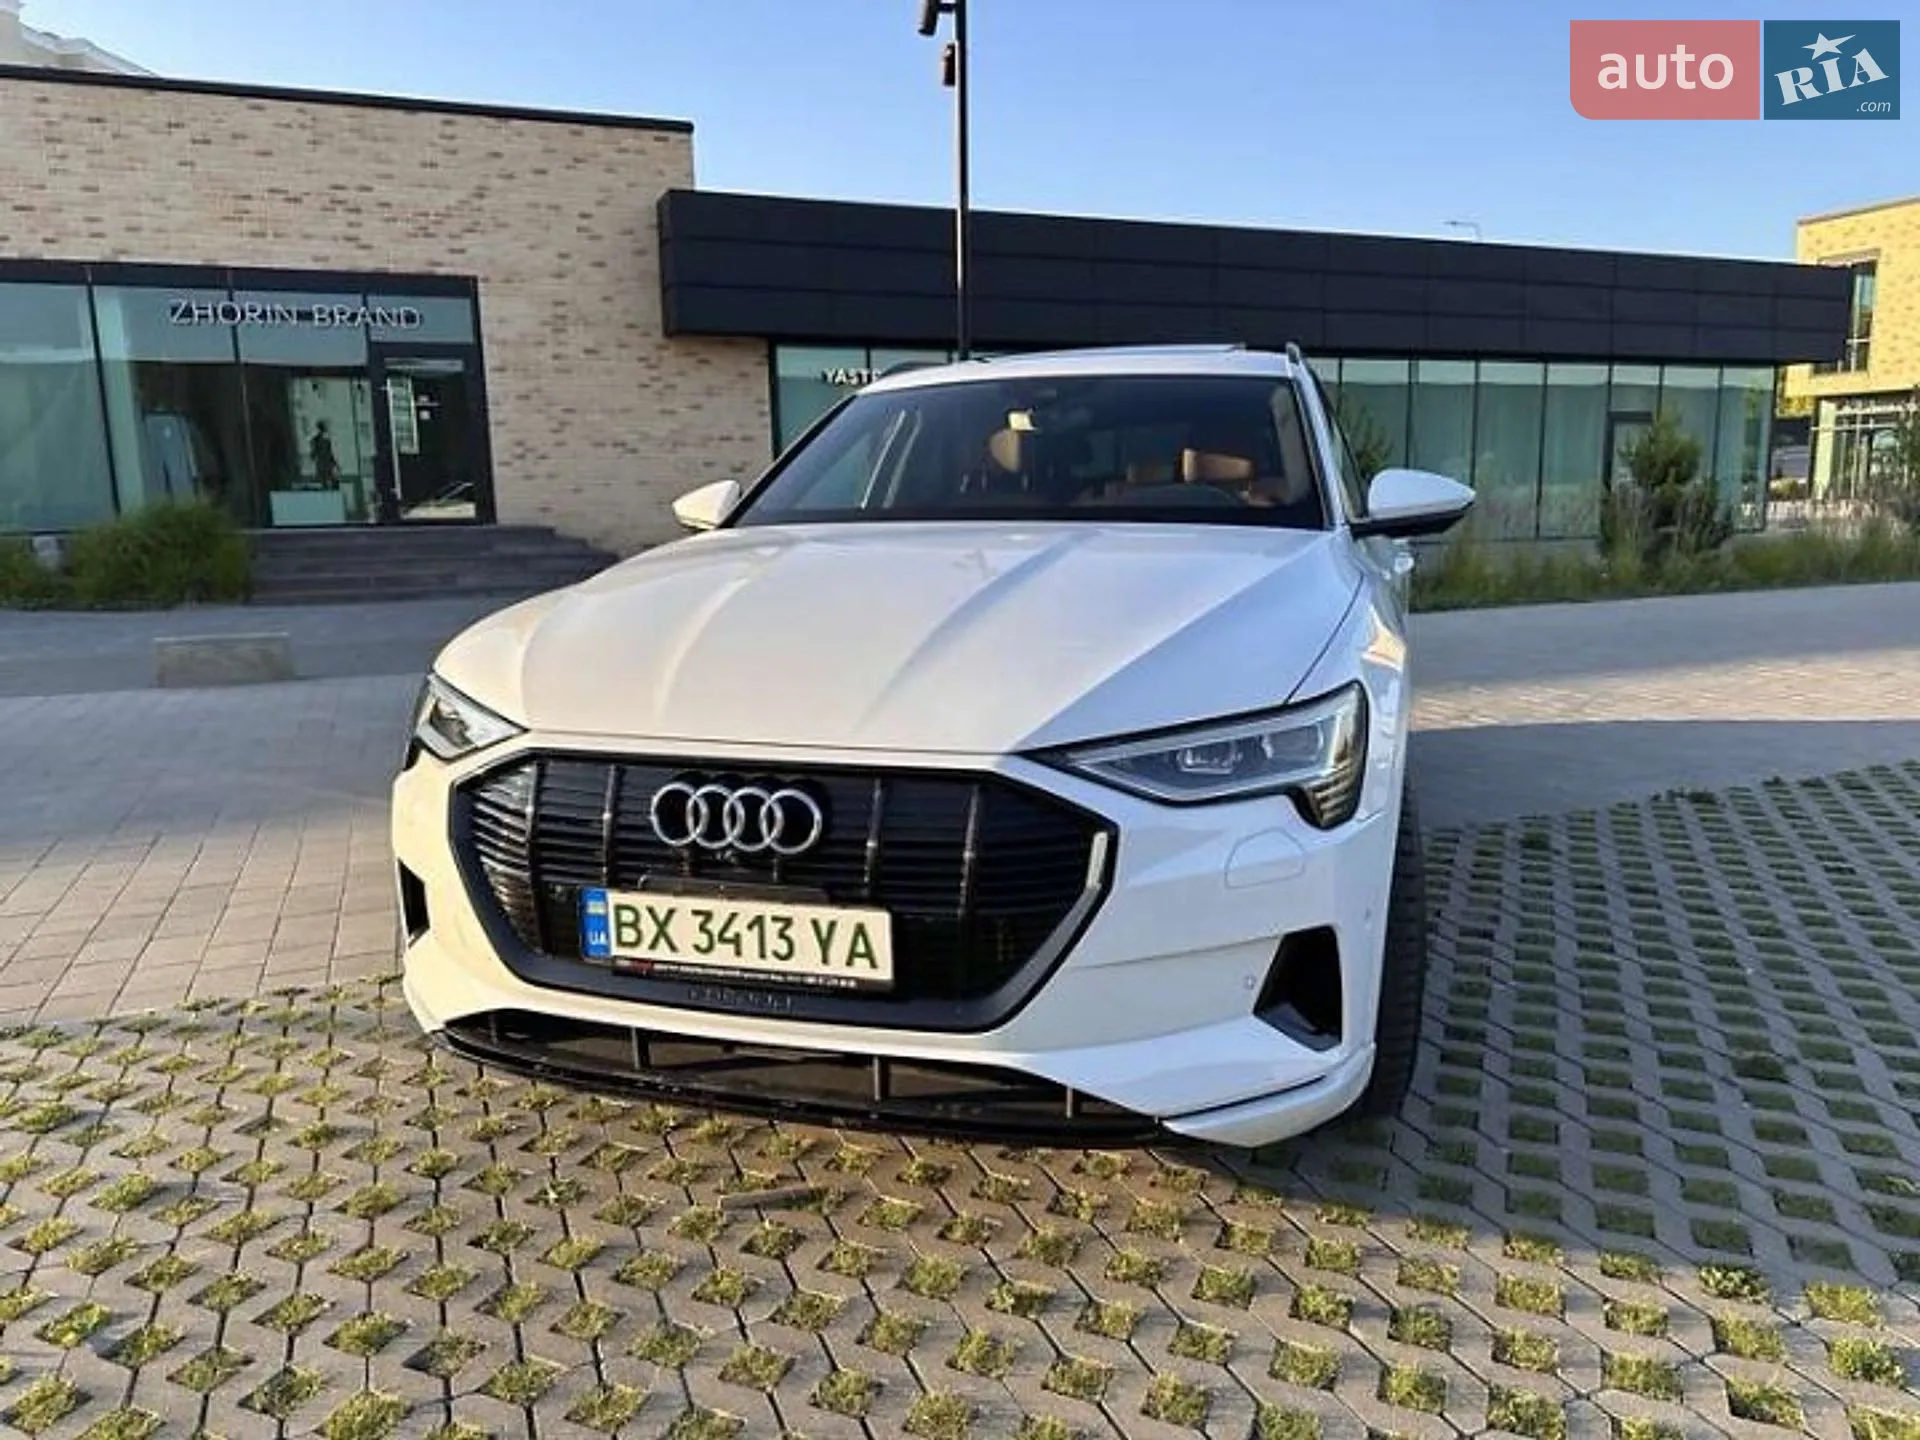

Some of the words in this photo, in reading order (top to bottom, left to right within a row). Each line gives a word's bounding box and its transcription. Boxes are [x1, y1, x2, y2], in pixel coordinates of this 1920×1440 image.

[170, 299, 299, 326] ZHORIN
[311, 304, 419, 329] BRAND
[587, 930, 609, 946] UA
[614, 903, 678, 953] BX
[691, 909, 795, 962] 3413
[811, 918, 879, 969] YA
